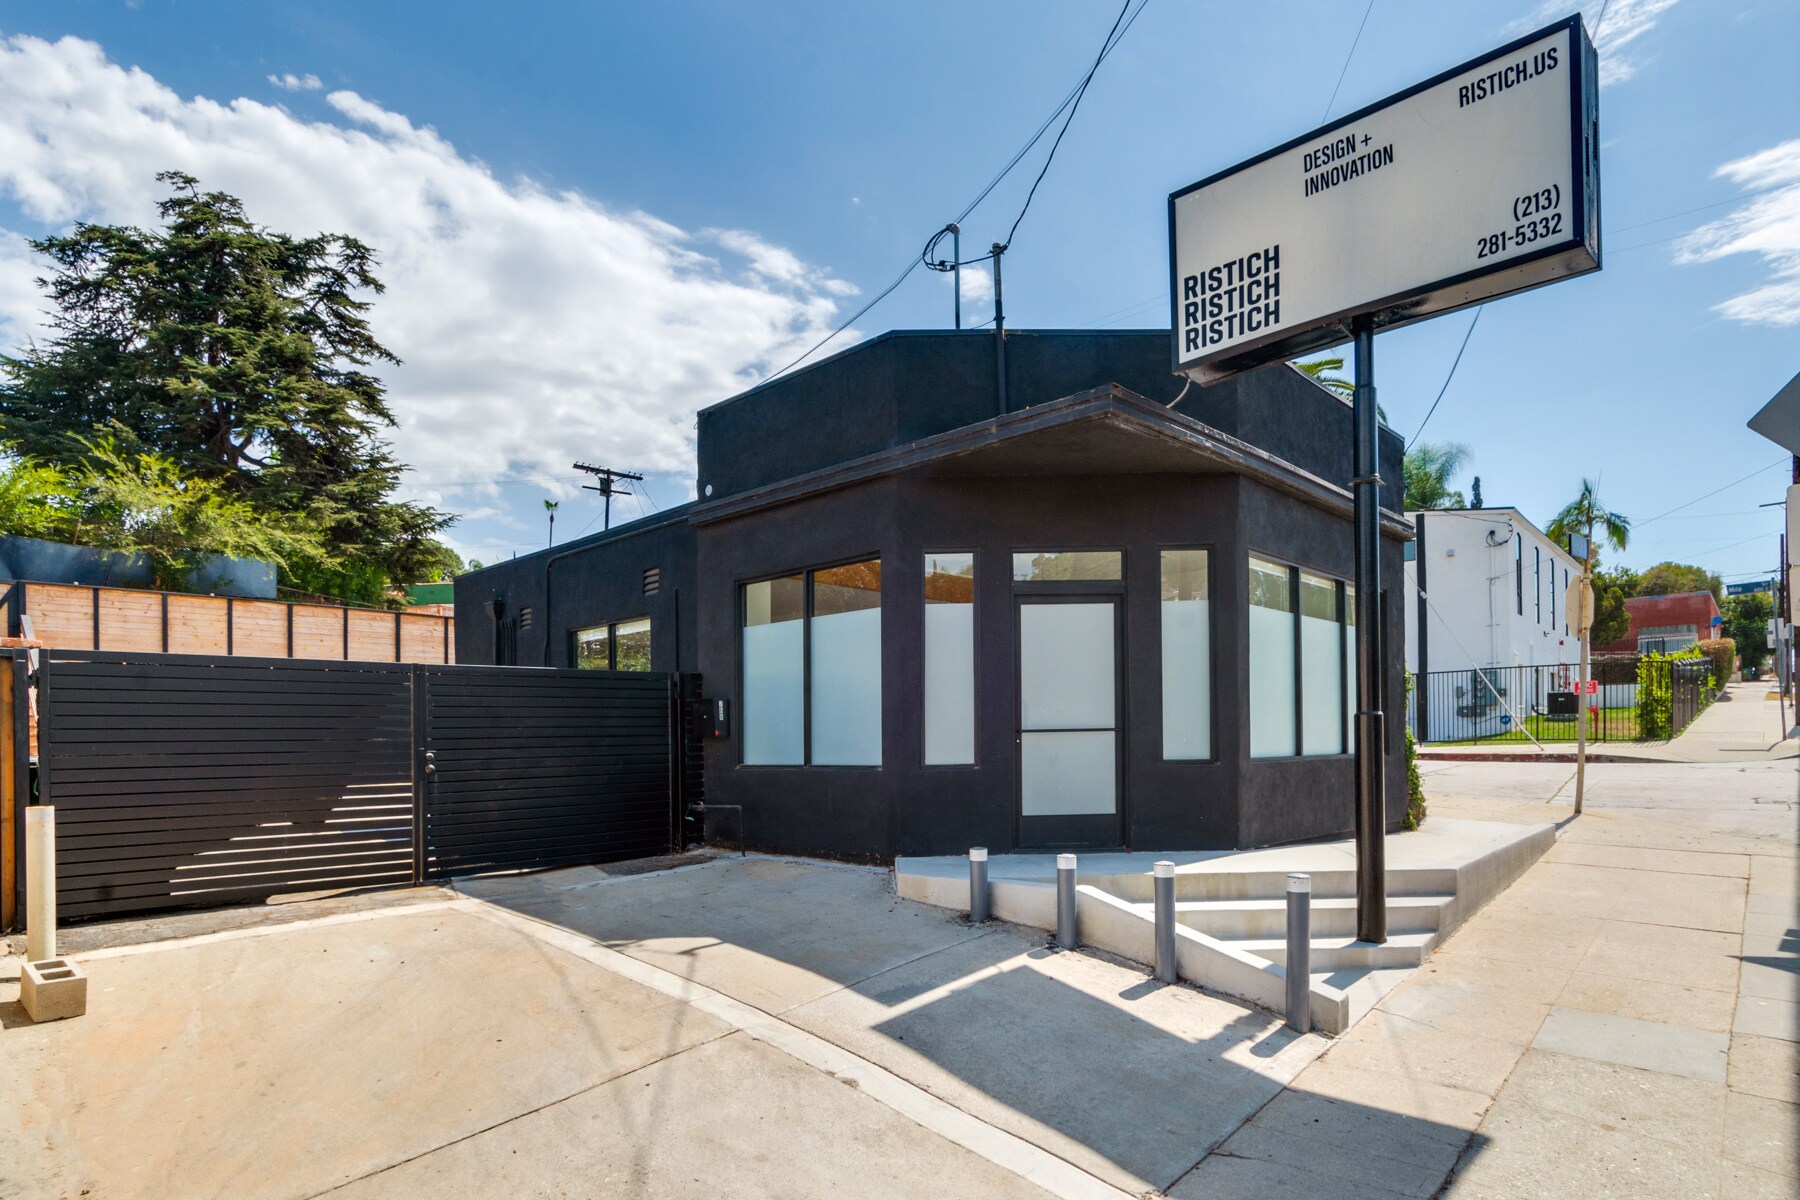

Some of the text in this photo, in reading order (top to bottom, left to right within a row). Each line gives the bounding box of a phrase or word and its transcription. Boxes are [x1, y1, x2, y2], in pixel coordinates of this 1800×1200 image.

[1458, 46, 1559, 109] RISTICH.US
[1303, 133, 1373, 174] DESIGN +
[1304, 144, 1394, 198] INNOVATION
[1513, 184, 1561, 223] (213)
[1477, 213, 1563, 260] 281-5332
[1183, 244, 1280, 302] RISTICH
[1184, 271, 1280, 328] RISTICH
[1185, 298, 1280, 353] RISTICH
